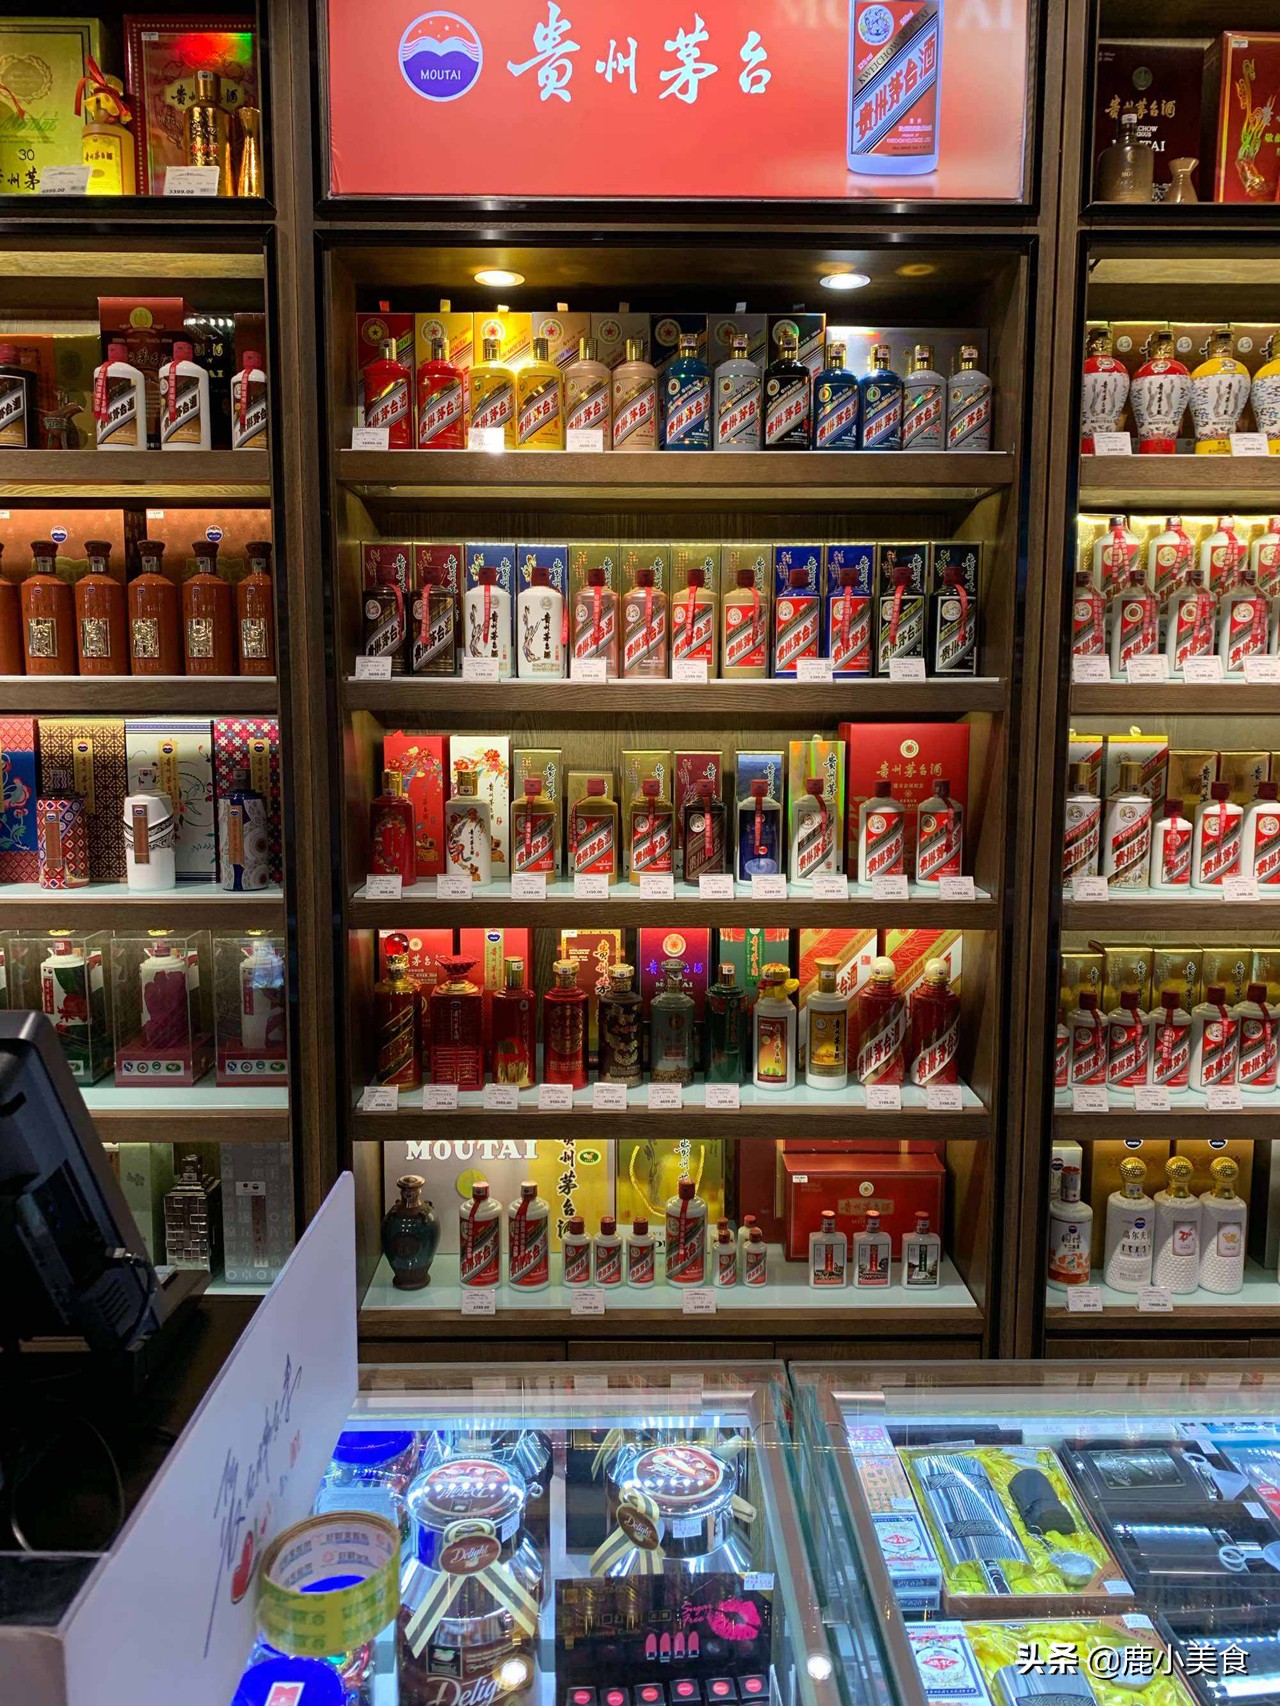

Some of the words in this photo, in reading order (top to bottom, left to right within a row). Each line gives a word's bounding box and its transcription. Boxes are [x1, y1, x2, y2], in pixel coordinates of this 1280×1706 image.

[420, 69, 461, 80] MOUTAI
[855, 31, 937, 144] 贵州茅台酒
[19, 149, 35, 161] 30
[876, 760, 943, 778] 贵州茅台酒
[405, 1140, 539, 1161] MOUTAI
[624, 1516, 653, 1537] Delight
[450, 1544, 490, 1564] Delight
